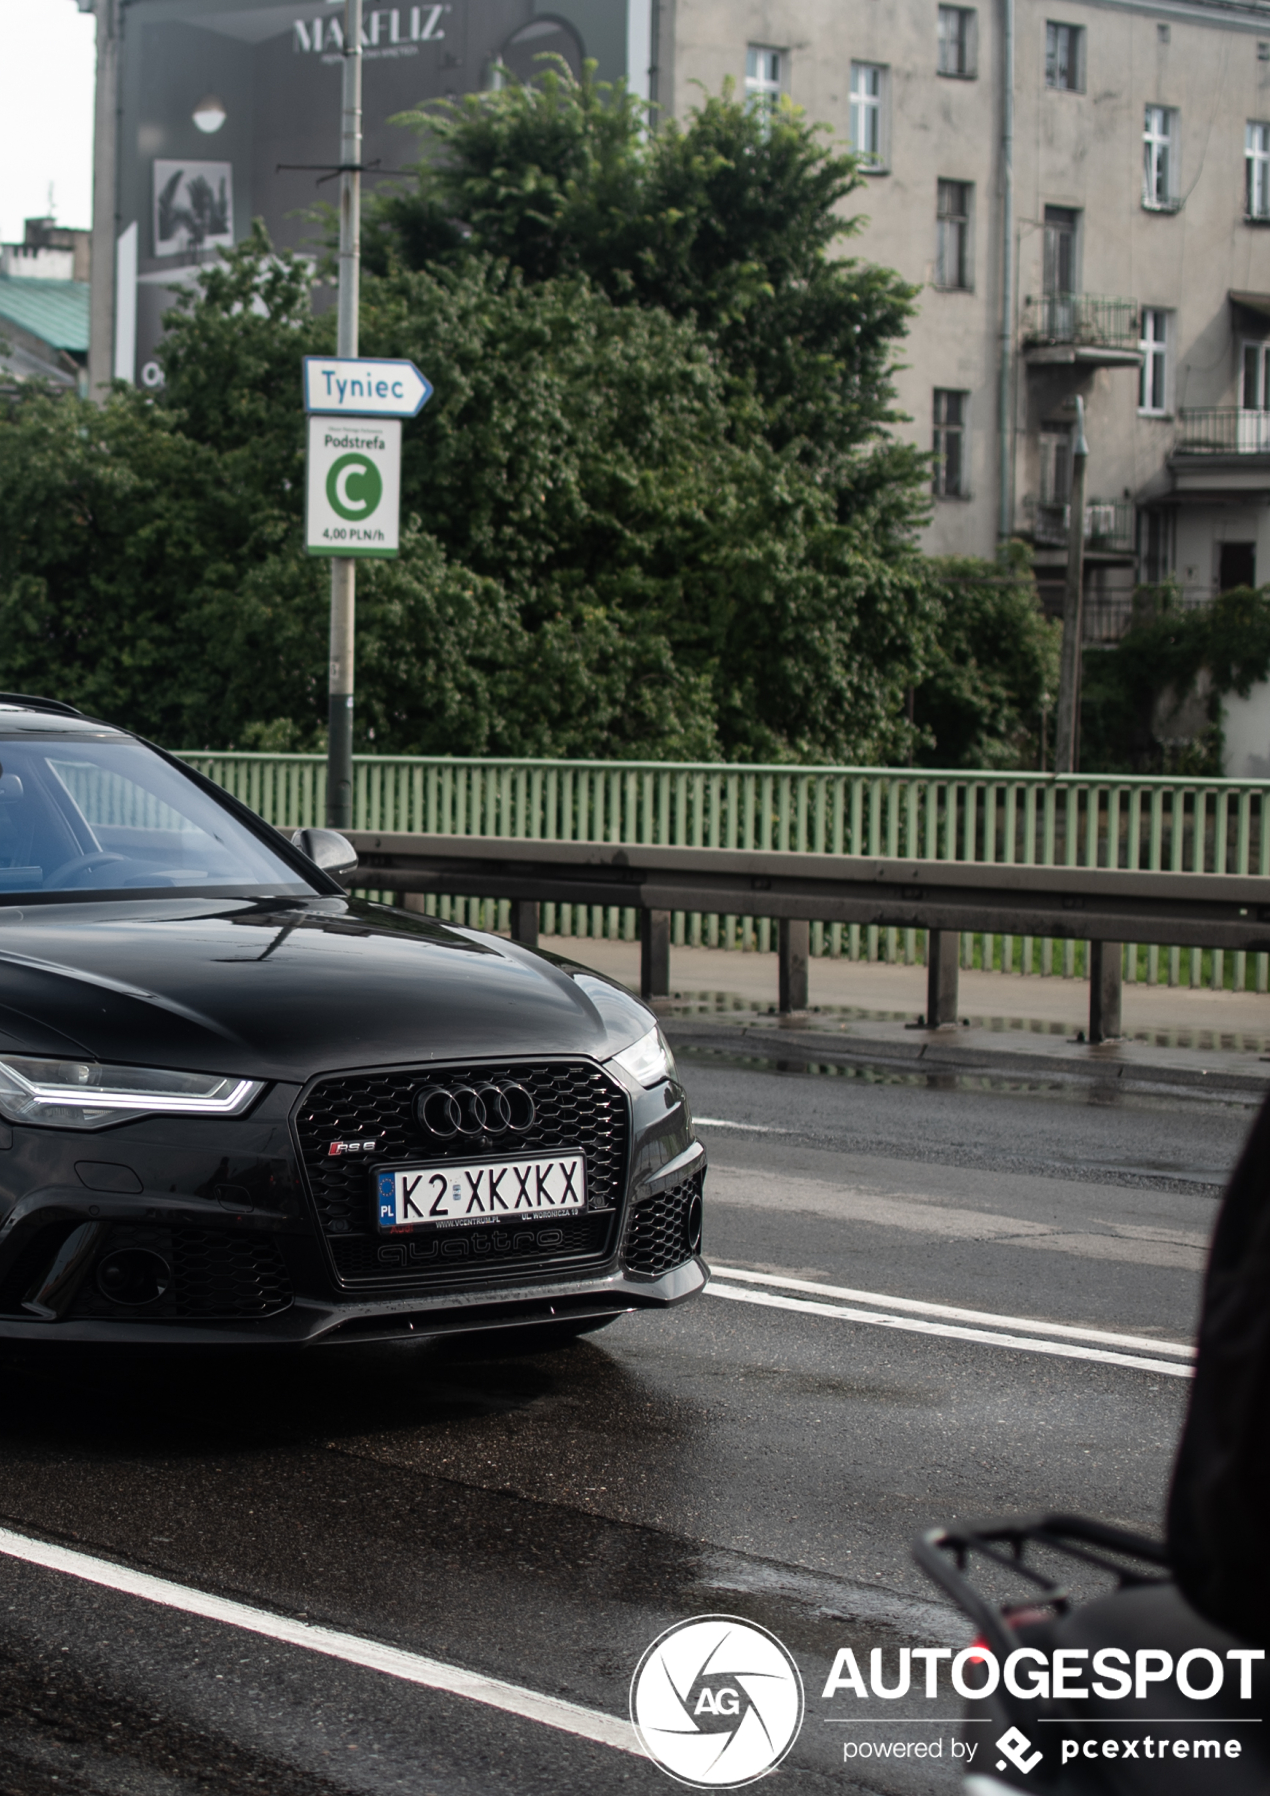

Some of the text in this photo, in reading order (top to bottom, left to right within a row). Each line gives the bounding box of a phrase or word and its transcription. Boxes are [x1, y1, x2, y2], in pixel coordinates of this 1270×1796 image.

[321, 370, 404, 404] Tyniec
[324, 434, 386, 450] Podstrefa
[336, 463, 368, 512] C
[322, 528, 385, 541] 4,00 PLN/h
[402, 1161, 579, 1219] K2 XKXKX
[381, 1206, 394, 1217] PL
[390, 1224, 414, 1234] Audi
[435, 1215, 501, 1229] WWW.VCENTRUM.PL
[377, 1229, 564, 1266] quattro
